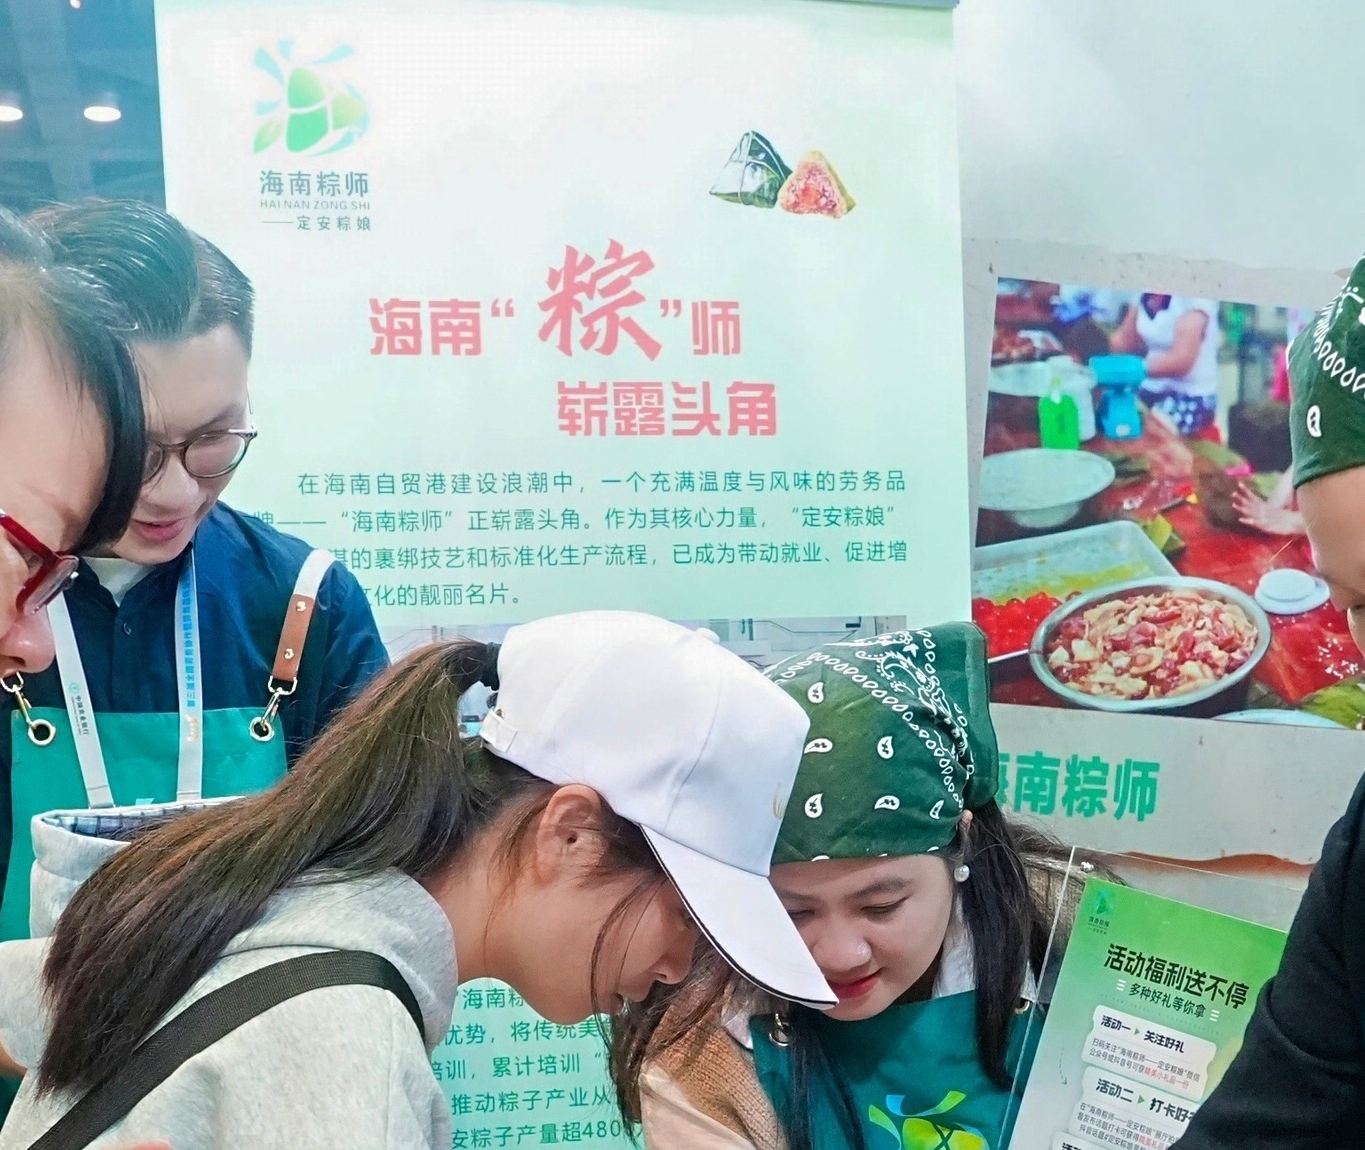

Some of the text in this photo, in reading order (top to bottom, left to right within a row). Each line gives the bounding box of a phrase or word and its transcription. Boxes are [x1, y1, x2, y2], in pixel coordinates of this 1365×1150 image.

[260, 169, 369, 197] 海南粽师
[260, 200, 371, 210] HAI NAN ZONG SHI
[557, 381, 778, 436] 崭露头角
[1104, 943, 1250, 1010] 活动福利送不停
[1129, 983, 1207, 1018] 多种好礼等你拿
[444, 1016, 613, 1046] 优势，将传统美
[1100, 1015, 1185, 1053] 活动一 关注好礼
[451, 1086, 611, 1116] 推动粽子产业从
[1096, 1078, 1134, 1103] 活动二
